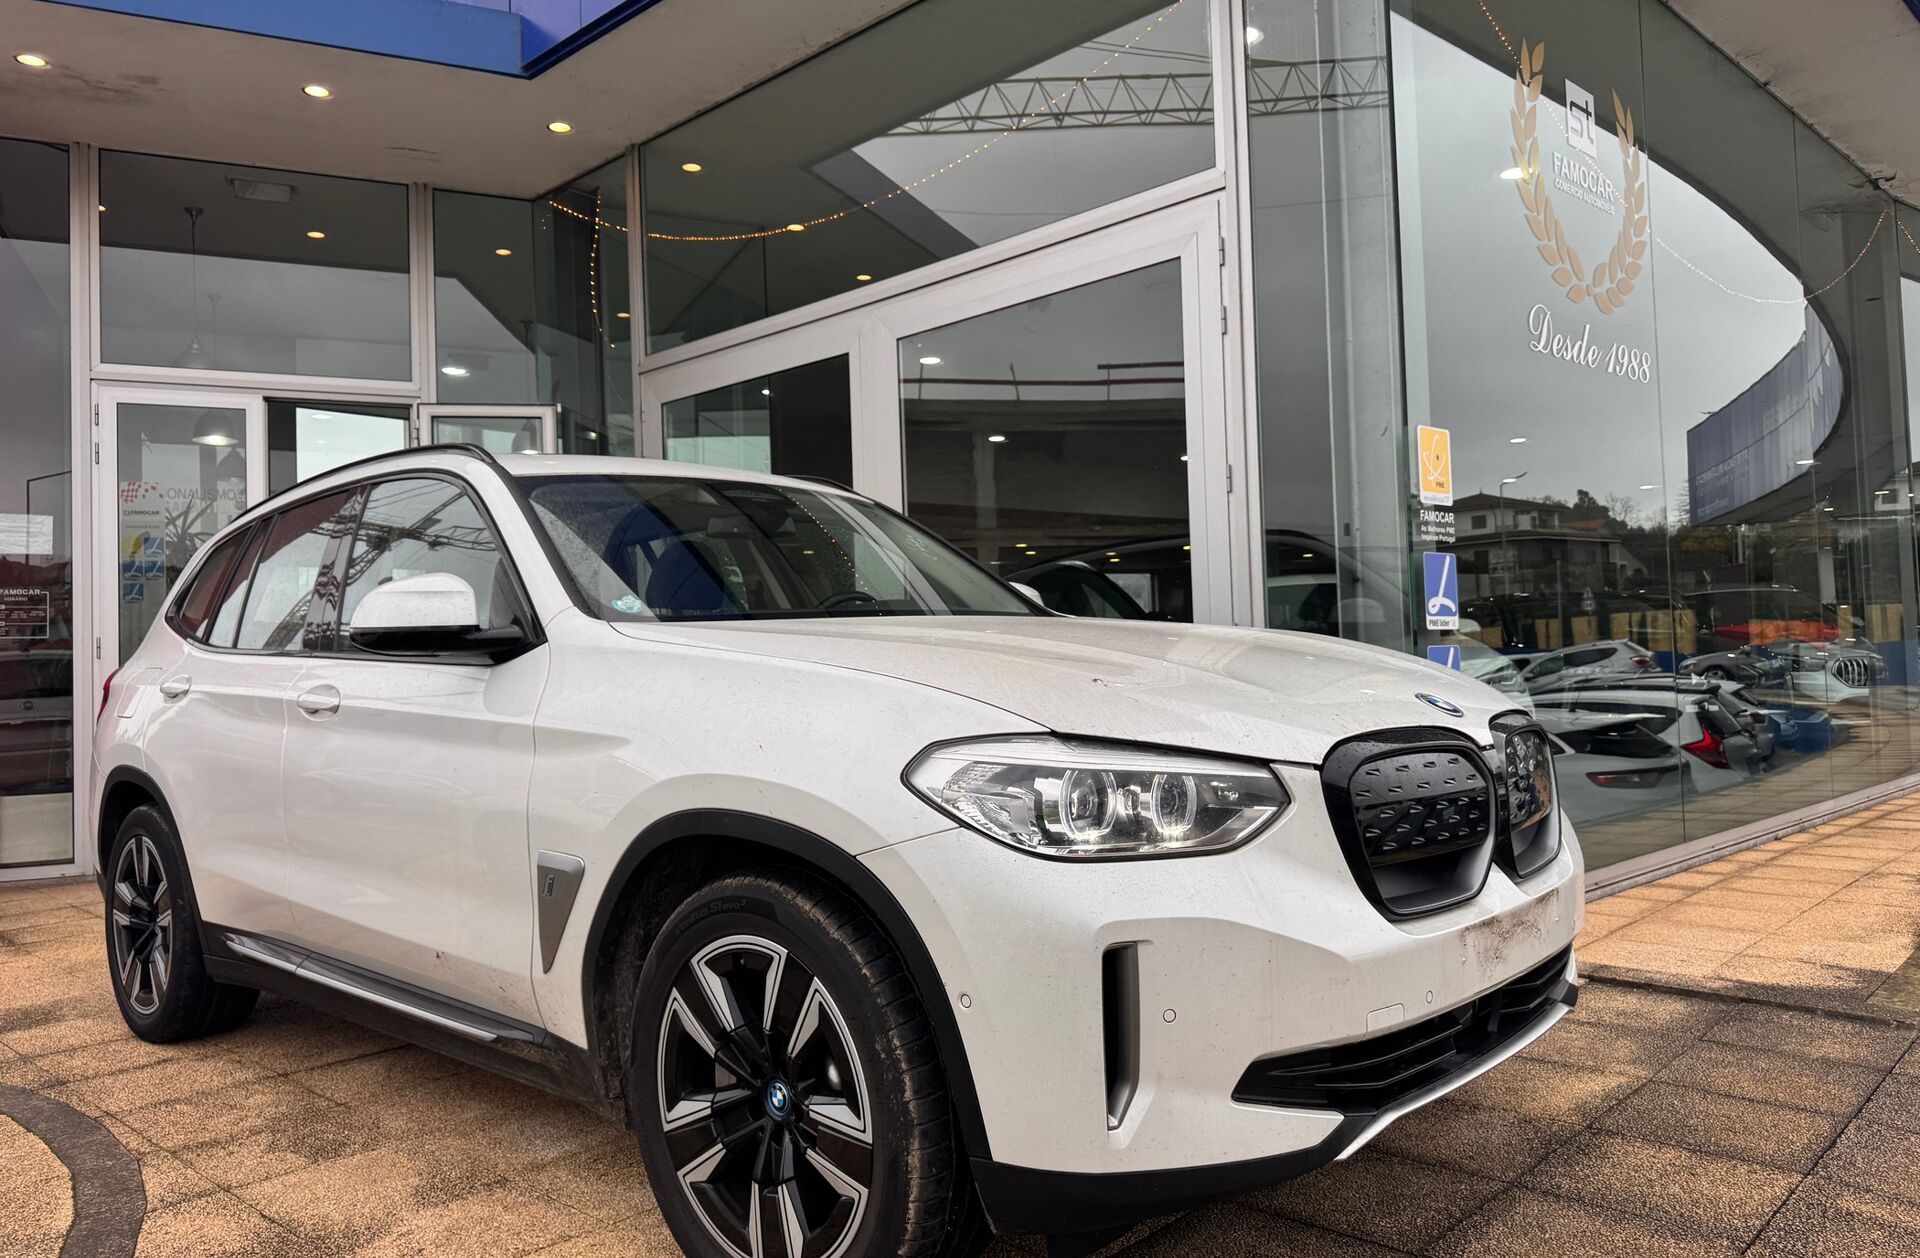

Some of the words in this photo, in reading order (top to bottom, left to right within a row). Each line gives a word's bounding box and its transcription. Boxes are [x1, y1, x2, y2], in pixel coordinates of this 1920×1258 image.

[1552, 151, 1614, 201] FAMOCAR
[1528, 304, 1603, 368] Desde
[1605, 342, 1651, 383] 1988
[1420, 509, 1455, 524] FAMOCAR
